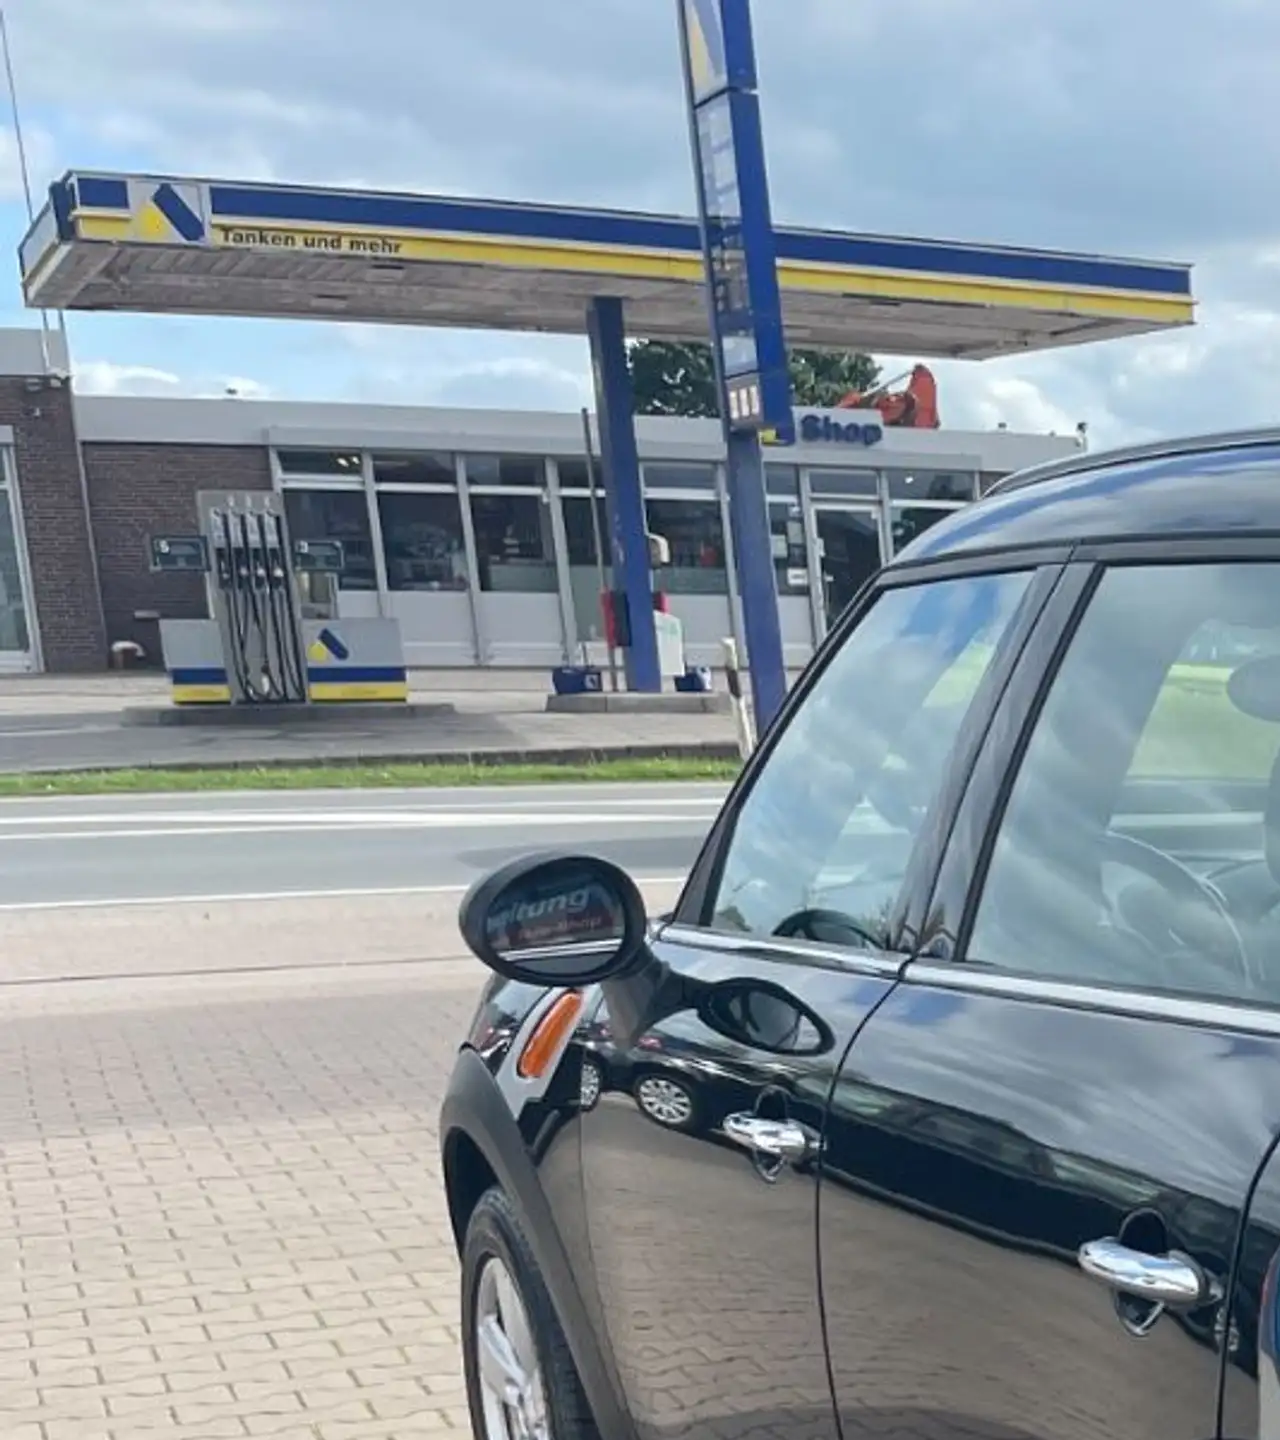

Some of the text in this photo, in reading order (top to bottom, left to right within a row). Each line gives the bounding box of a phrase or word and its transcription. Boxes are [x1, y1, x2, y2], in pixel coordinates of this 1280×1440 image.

[221, 227, 403, 253] Tanken und mehr
[801, 414, 883, 446] Shop
